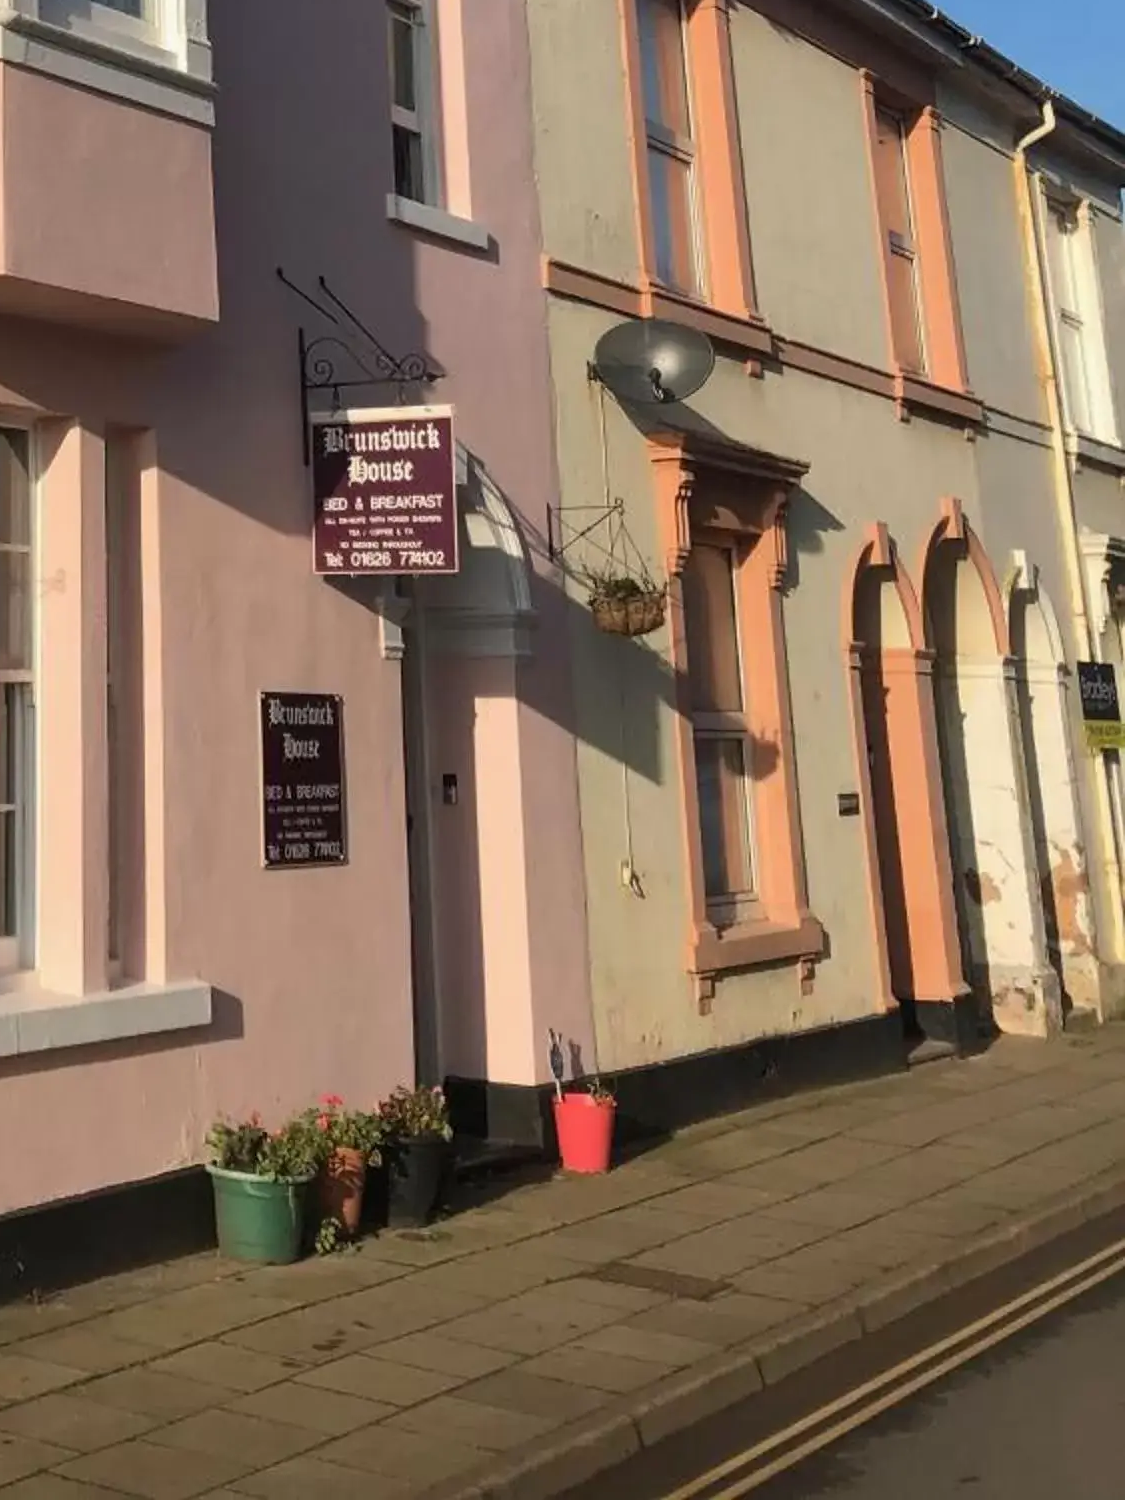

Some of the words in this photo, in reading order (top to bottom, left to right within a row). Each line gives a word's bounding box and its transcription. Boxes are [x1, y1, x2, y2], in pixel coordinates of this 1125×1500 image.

[323, 422, 441, 456] Brunswick
[347, 455, 414, 487] House
[323, 497, 348, 511] BED
[355, 496, 364, 510] &
[370, 494, 444, 510] BREAKFAST
[350, 551, 391, 567] 01626
